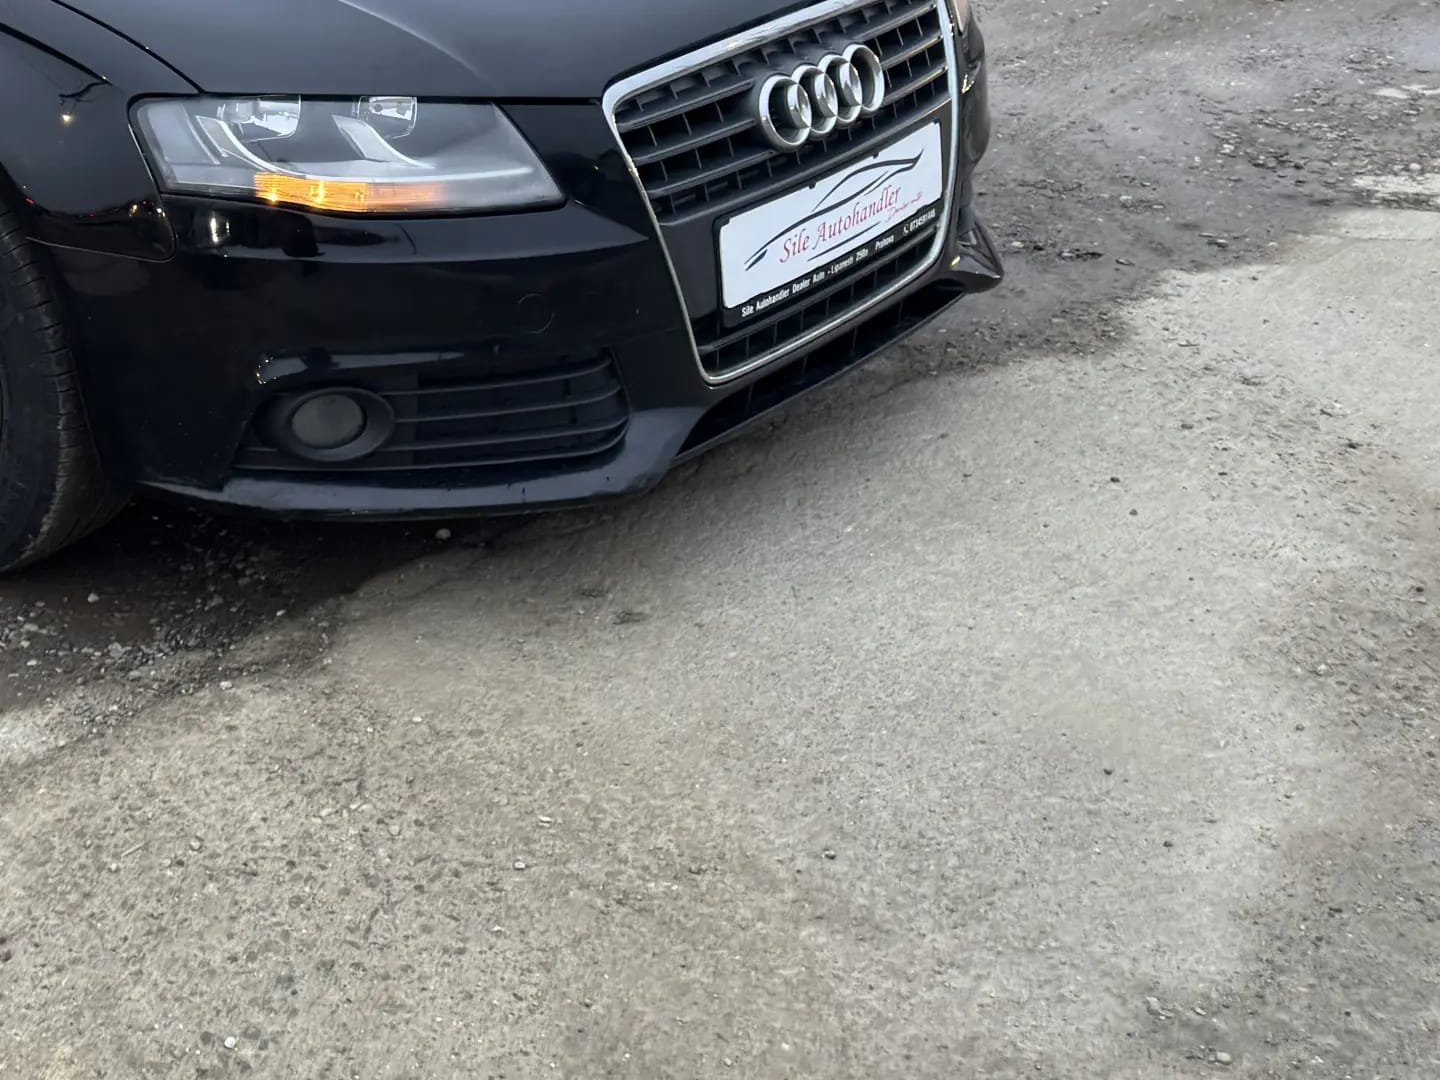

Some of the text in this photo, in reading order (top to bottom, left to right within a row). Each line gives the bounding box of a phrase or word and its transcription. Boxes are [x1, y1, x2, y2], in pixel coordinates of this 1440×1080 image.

[779, 227, 810, 264] Sile
[811, 184, 901, 250] Autohandler
[741, 305, 754, 318] Sile
